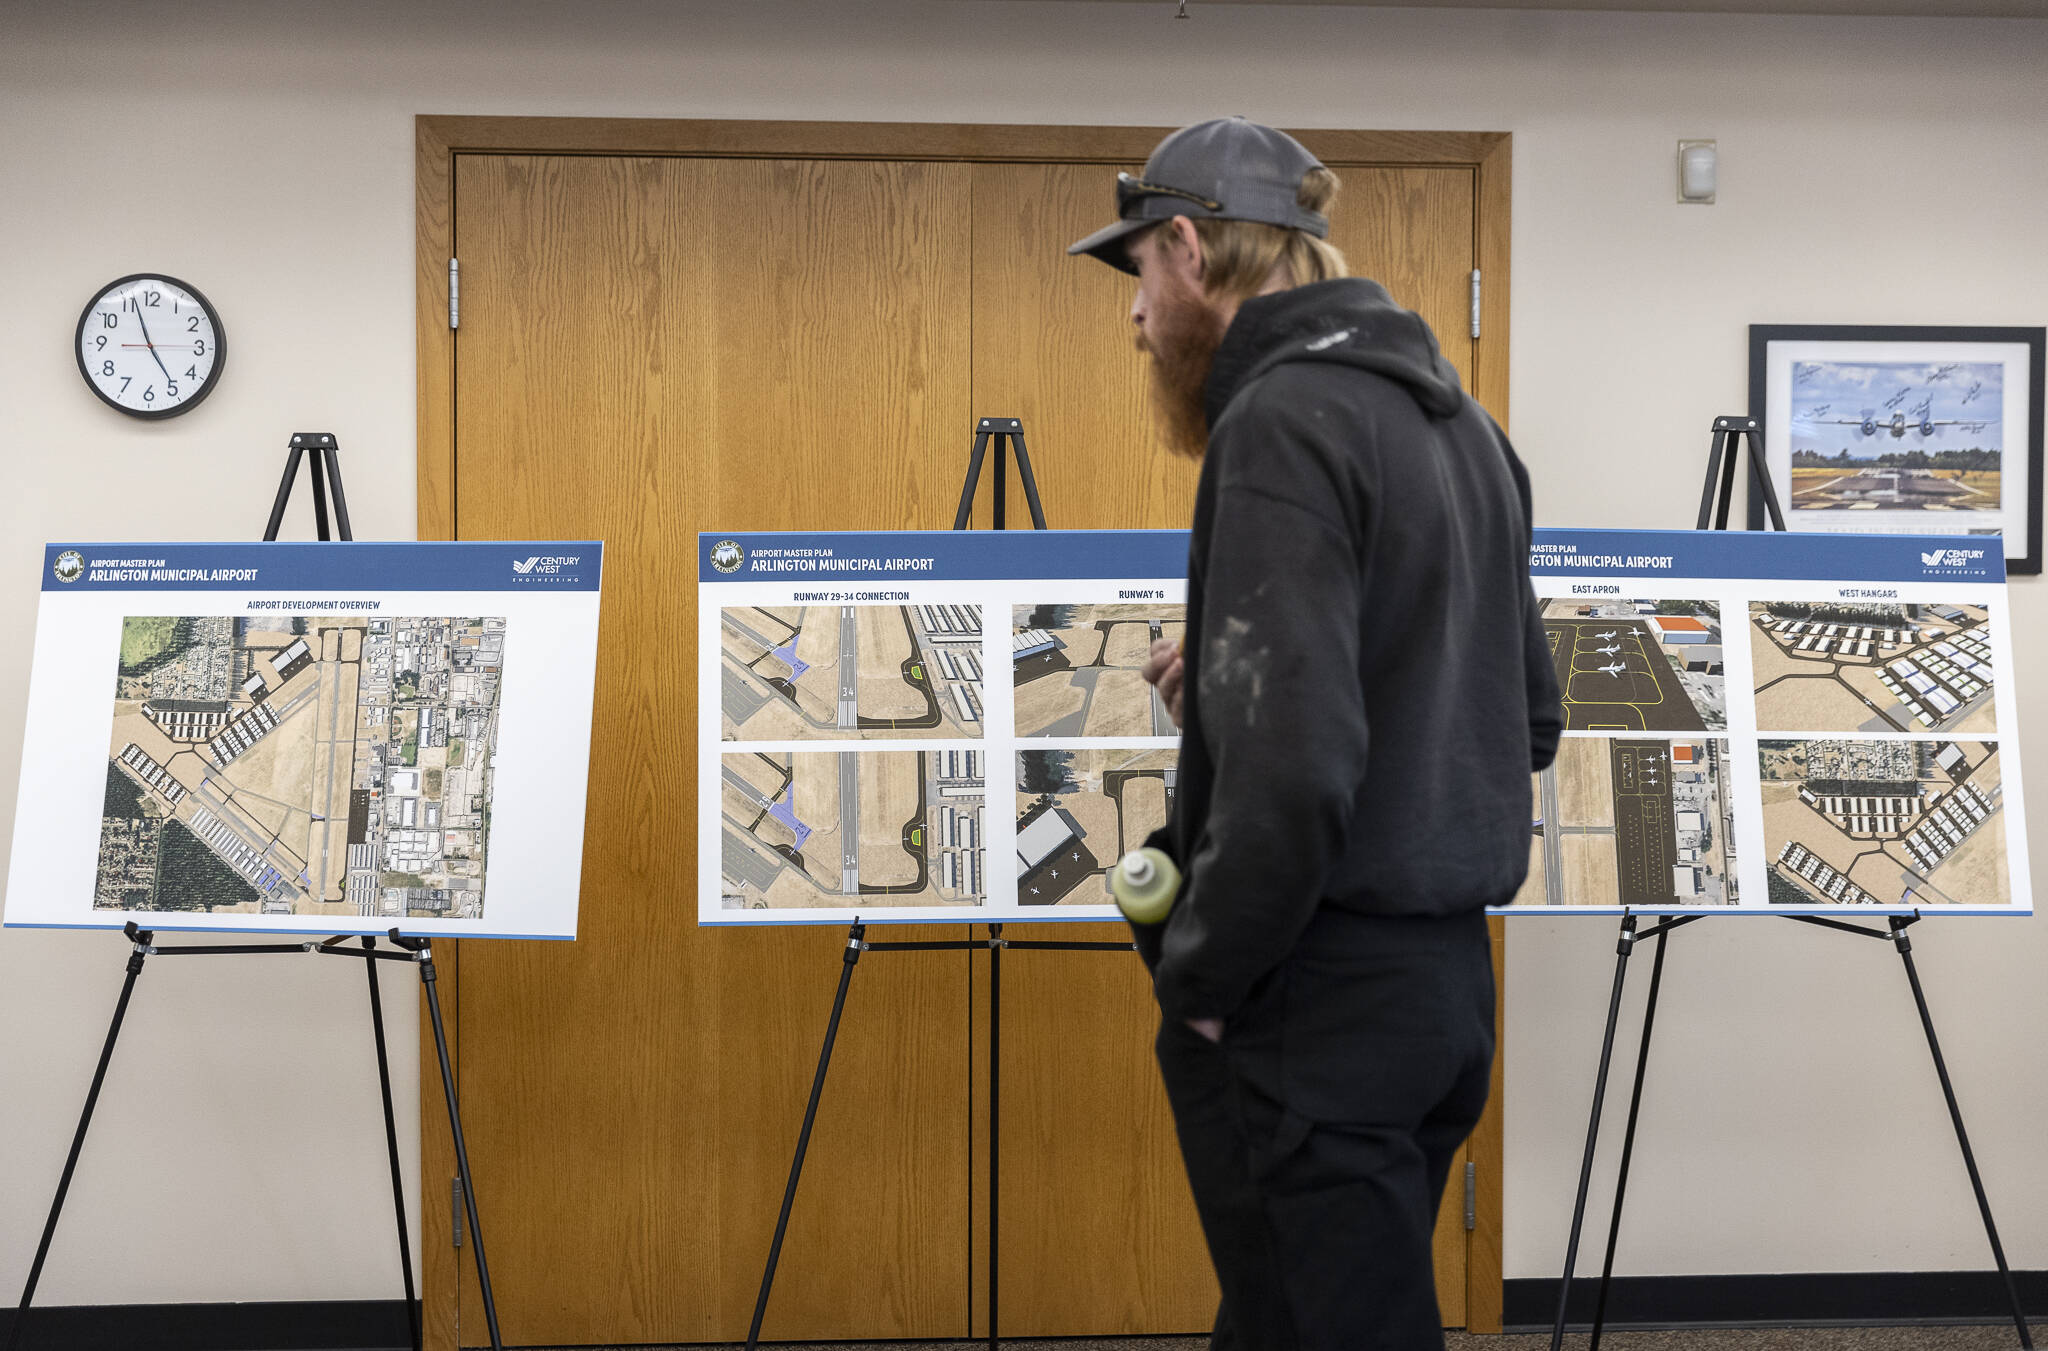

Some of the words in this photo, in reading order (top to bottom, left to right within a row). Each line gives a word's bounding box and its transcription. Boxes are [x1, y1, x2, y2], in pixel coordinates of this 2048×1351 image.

[122, 297, 135, 313] 11
[144, 291, 161, 307] 12
[102, 313, 118, 329] 10
[187, 316, 200, 333] 2
[96, 335, 108, 352] 9
[193, 339, 205, 356] 3
[102, 360, 115, 377] 8
[184, 363, 197, 380] 4
[120, 376, 133, 393] 7
[166, 379, 179, 397] 5
[143, 384, 155, 401] 6
[751, 549, 783, 558] AIRPORT
[783, 549, 813, 558] MASTER
[814, 549, 833, 558] PLAN
[1558, 545, 1577, 554] PLAN
[1946, 549, 1985, 559] CENTURY
[90, 559, 120, 568] AIRPORT
[120, 559, 147, 568] MASTER
[148, 559, 166, 568] PLAN
[540, 556, 580, 566] CENTURY
[751, 559, 816, 572] ARLINGTON
[818, 559, 882, 572] MUNICIPAL
[883, 558, 934, 571] AIRPORT
[1563, 555, 1625, 568] MUNICIPAL
[1626, 556, 1673, 569] AIRPORT
[1942, 558, 1967, 567] WEST
[88, 569, 149, 582] ARLINGTON
[150, 569, 209, 582] MUNICIPAL
[210, 569, 258, 581] AIRPORT
[535, 565, 560, 574] WEST
[793, 592, 829, 601] RUNWAY
[830, 592, 854, 601] 29-34
[855, 591, 910, 601] CONNECTION
[1119, 590, 1154, 599] RUNWAY
[1155, 590, 1164, 599] 16
[1572, 585, 1591, 594] EAST
[1592, 585, 1620, 595] APRON
[1838, 588, 1861, 598] WEST
[1860, 589, 1898, 599] HANGARS
[247, 600, 281, 610] AIRPORT
[282, 600, 338, 610] DEVELOPMENT
[339, 600, 381, 610] OVERVIEW
[842, 687, 854, 697] 34
[845, 855, 856, 865] 34
